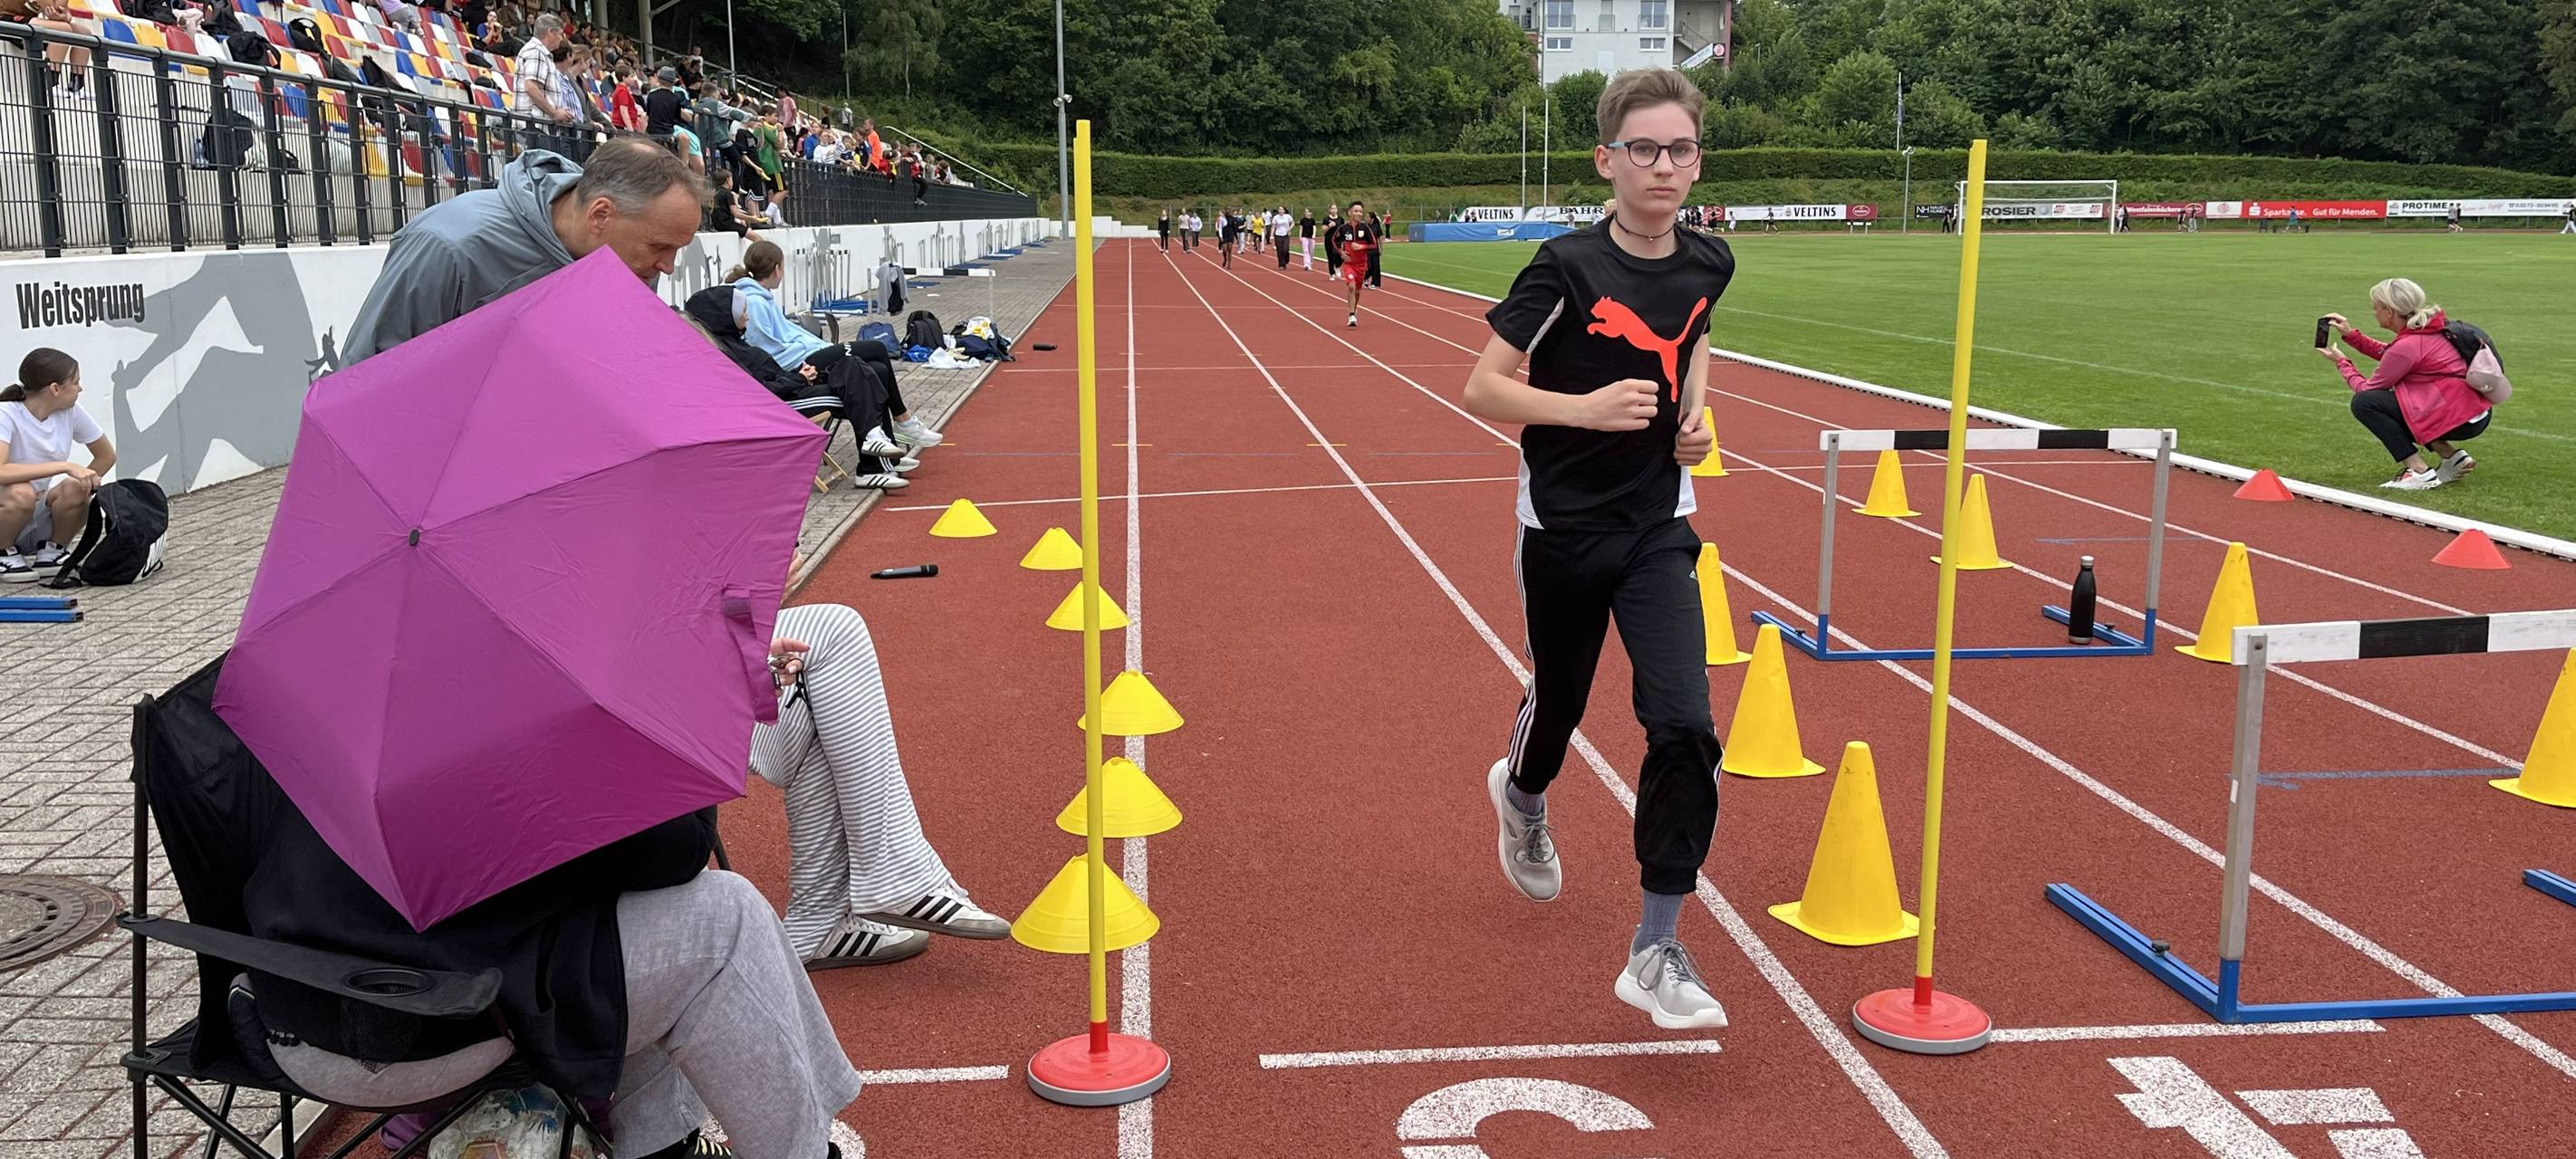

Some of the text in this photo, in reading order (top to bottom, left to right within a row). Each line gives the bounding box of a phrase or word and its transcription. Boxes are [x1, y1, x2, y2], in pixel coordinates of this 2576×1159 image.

[1478, 208, 1514, 220] VELTINS
[1793, 206, 1836, 216] VELTINS
[1982, 206, 2036, 216] ROSIER
[2264, 208, 2307, 217] Sparkase.
[2329, 207, 2341, 216] für
[15, 282, 146, 329] Weitsprung
